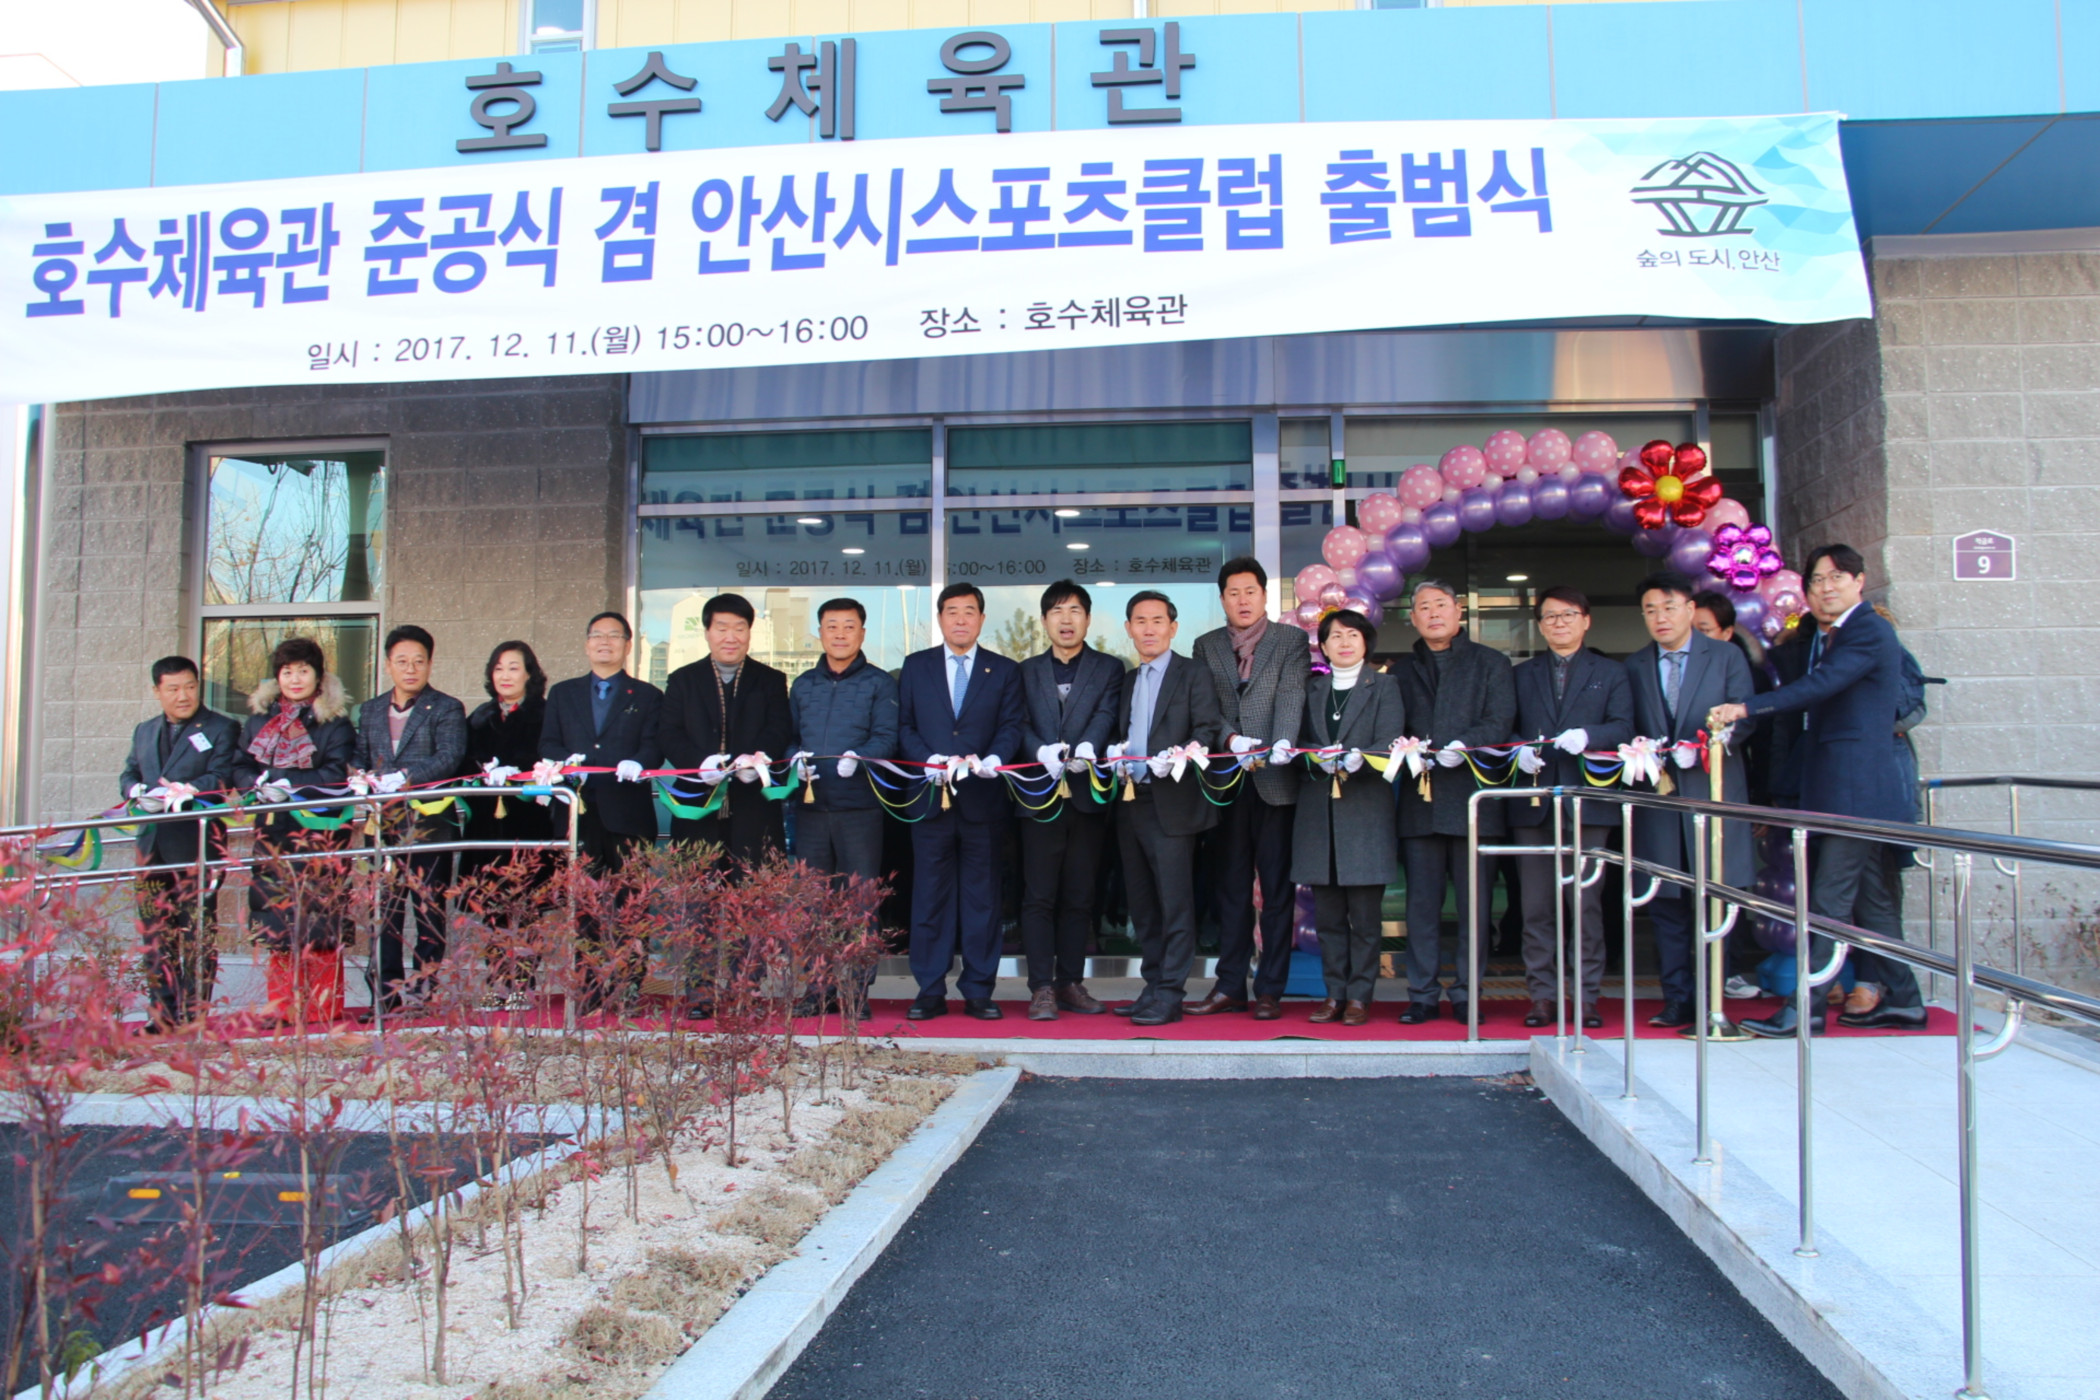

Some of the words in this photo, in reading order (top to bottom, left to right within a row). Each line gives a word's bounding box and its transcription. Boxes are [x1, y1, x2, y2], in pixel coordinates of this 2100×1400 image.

[26, 201, 340, 318] 호수체육관
[364, 187, 563, 297] 준공식
[594, 181, 660, 283] 겸
[691, 153, 1284, 275] 안산시스포츠클럽
[1320, 147, 1553, 245] 출범식
[1637, 248, 1681, 268] 숲의
[1738, 249, 1780, 272] 안산
[307, 340, 358, 371] 일시
[394, 336, 471, 362] 2017.
[490, 333, 529, 358] 12.
[547, 325, 641, 357] 11.(월)
[658, 315, 869, 351] 15:00~16:00
[919, 307, 982, 339] 장소
[1023, 293, 1188, 332] 호수체육관
[736, 560, 768, 578] 일시
[789, 560, 835, 576] 2017.
[842, 560, 867, 576] 12.
[1072, 557, 1106, 576] 장소
[1128, 556, 1213, 574] 호수체육관
[1977, 555, 1991, 574] 9
